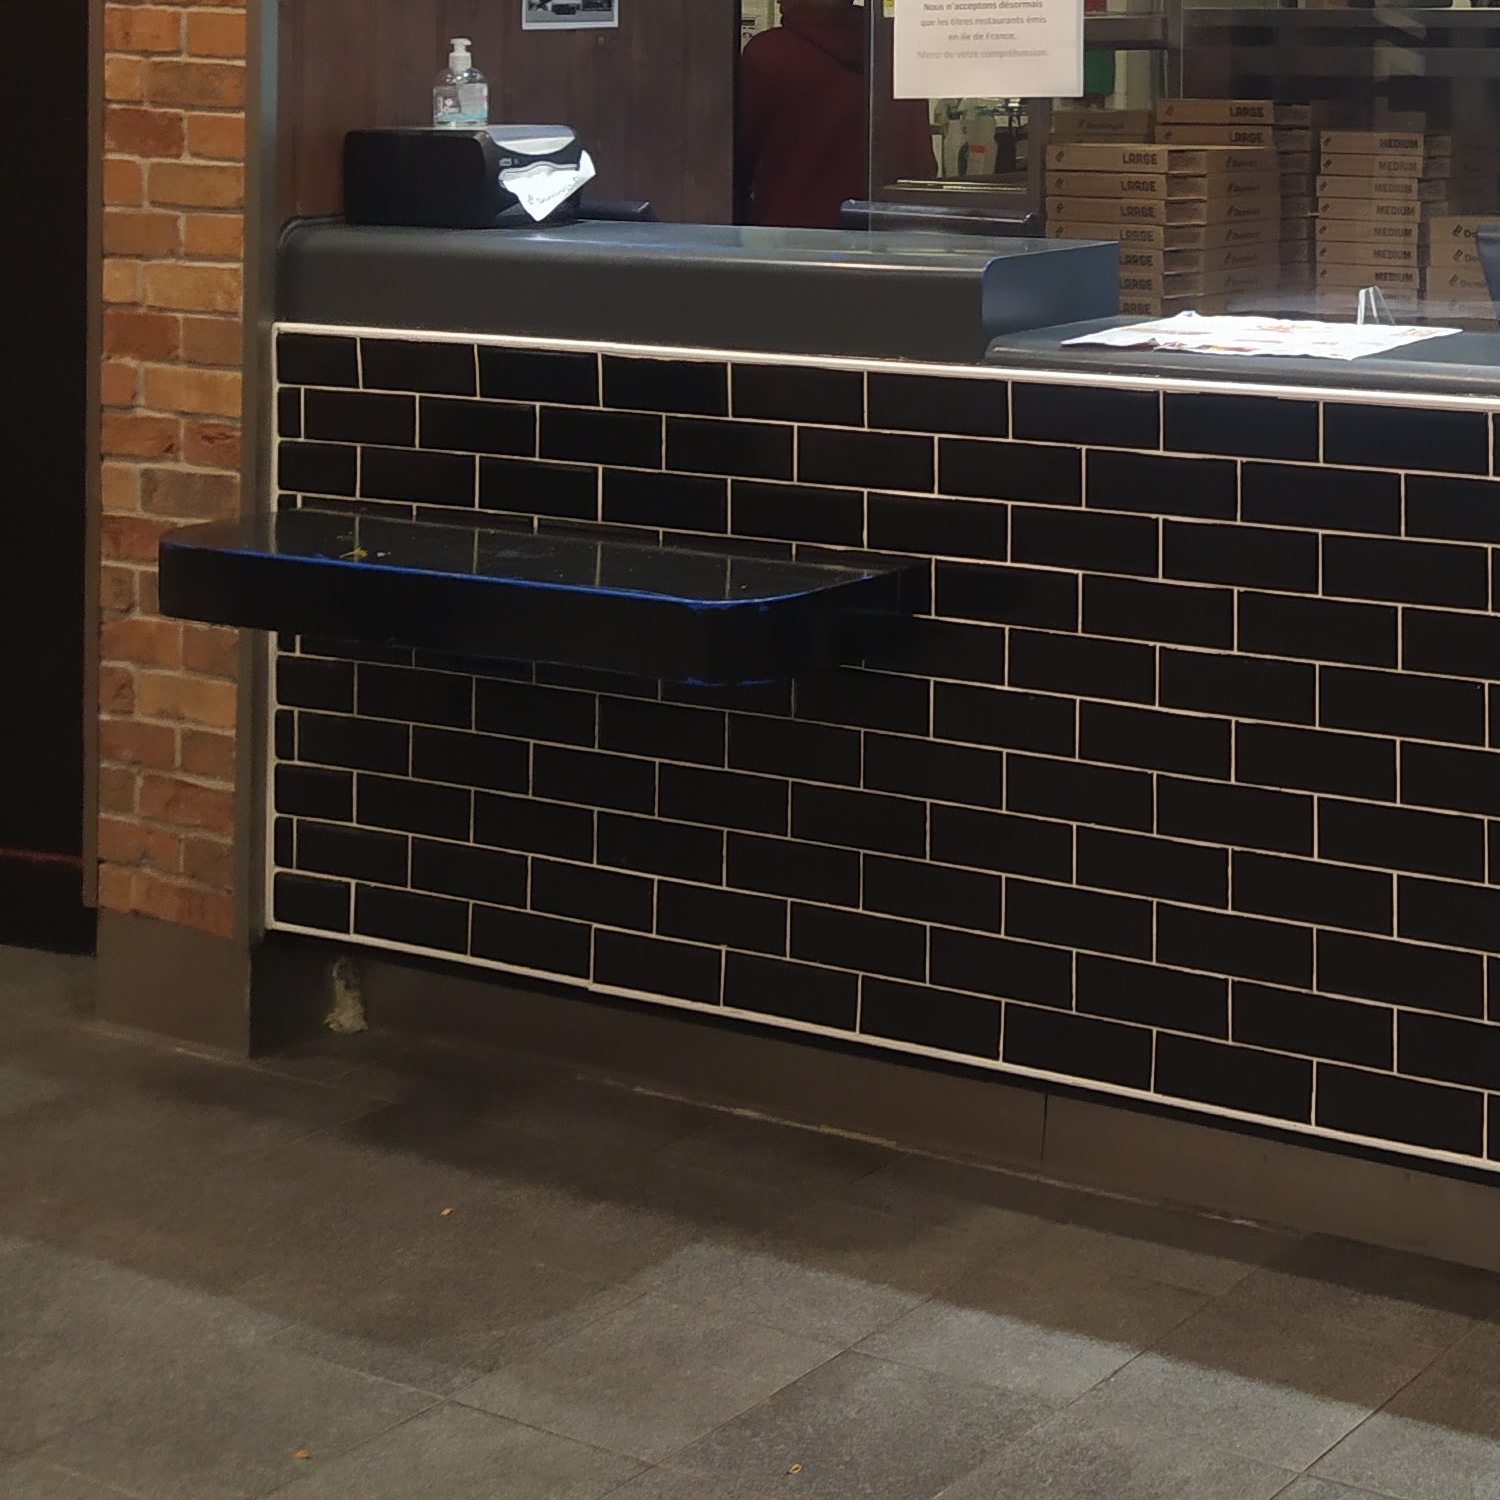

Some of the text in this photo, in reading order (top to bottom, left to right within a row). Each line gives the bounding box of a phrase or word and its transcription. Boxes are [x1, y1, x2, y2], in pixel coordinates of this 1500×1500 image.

[923, 0, 1044, 12] Nous n'acceptons désormais
[920, 19, 936, 28] que
[937, 17, 950, 27] les
[950, 16, 974, 26] titres
[974, 16, 1025, 26] restaurants
[972, 32, 984, 41] de
[1229, 106, 1265, 117] LARGE
[1228, 132, 1264, 143] LARGE
[1379, 138, 1419, 149] MEDIUM
[1122, 152, 1158, 165] LARGE
[1379, 161, 1418, 171] MEDIUM
[1120, 180, 1156, 192] LARGE
[1374, 183, 1413, 193] MEDIUM
[1120, 206, 1156, 218] LARGE
[1376, 205, 1415, 215] MEDIUM
[1119, 229, 1154, 242] LARGE
[1374, 227, 1413, 237] MEDIUM
[1373, 249, 1412, 260] MEDIUM
[1375, 272, 1414, 282] MEDIUM
[1122, 303, 1152, 315] ARGE
